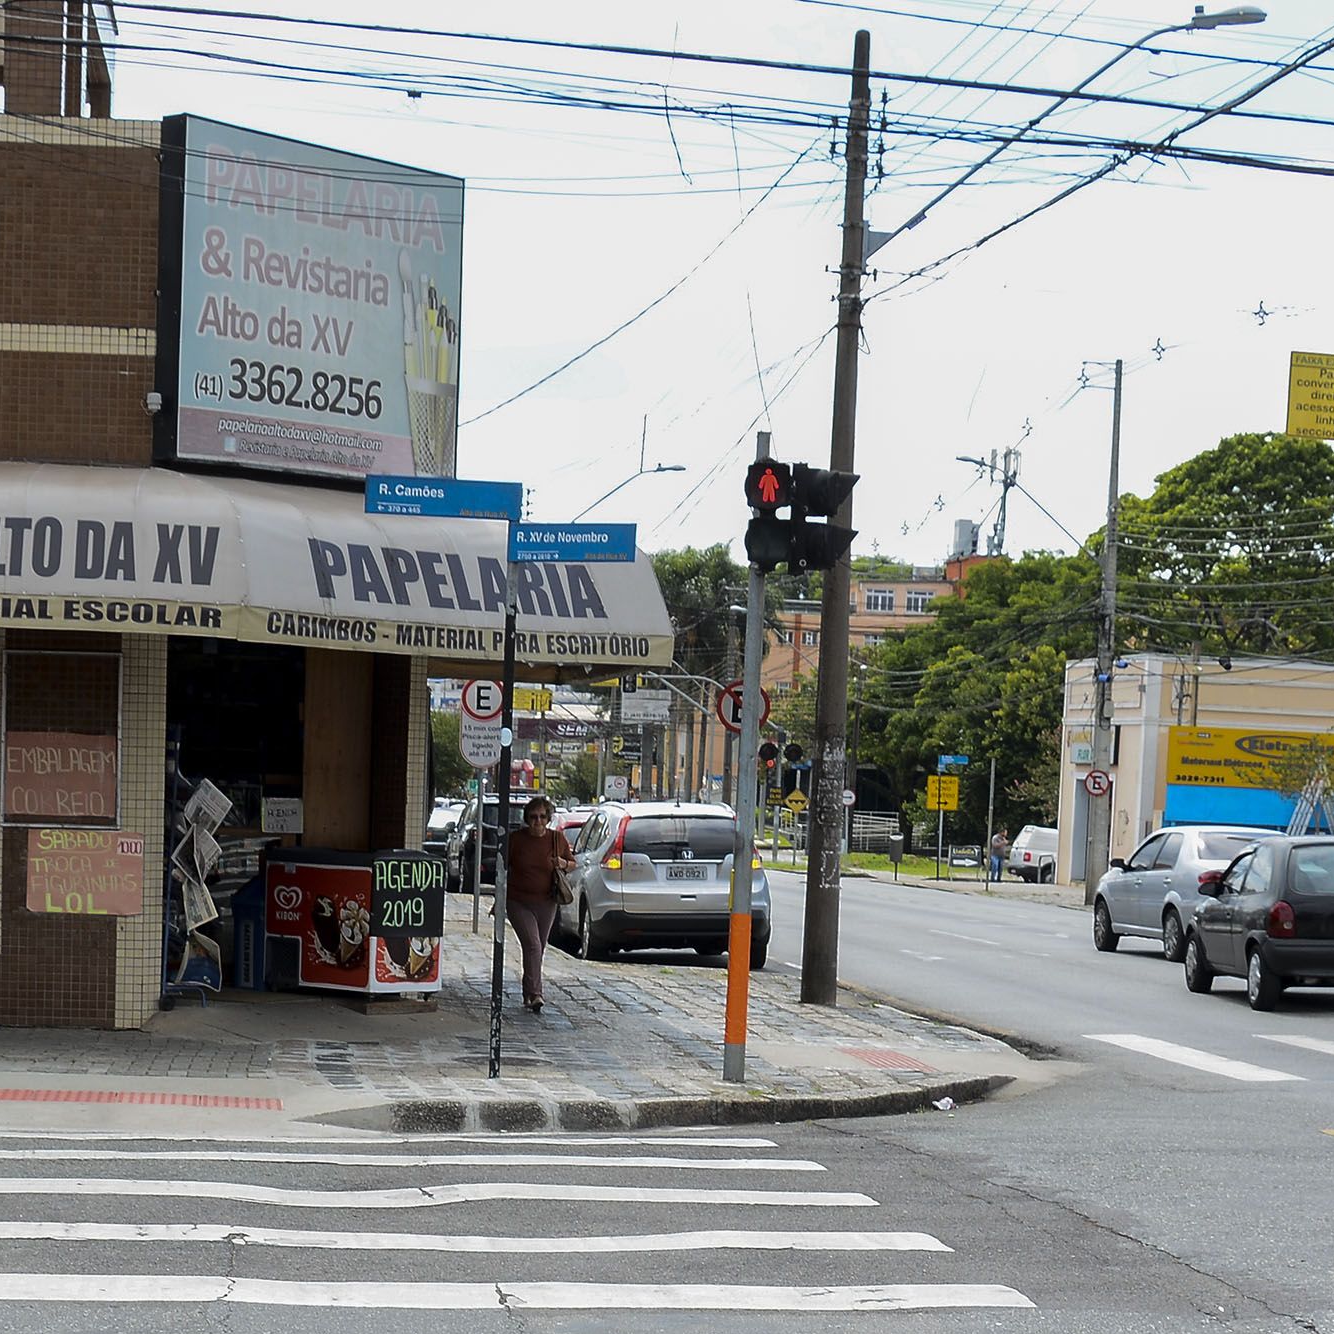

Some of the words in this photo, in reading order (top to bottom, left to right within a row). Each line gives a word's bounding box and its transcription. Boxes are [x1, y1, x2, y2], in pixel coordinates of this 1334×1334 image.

[204, 144, 445, 253] PAPELARIA
[201, 228, 232, 279] &
[242, 237, 389, 306] Revistaria
[197, 296, 259, 342] Alto
[267, 306, 303, 349] da
[311, 312, 355, 356] XV
[1295, 355, 1324, 366] FAIXA
[193, 371, 224, 402] (41)
[228, 358, 383, 420] 3362.8256
[379, 484, 391, 496] R.
[516, 532, 528, 543] R.
[529, 532, 543, 543] XV
[543, 532, 555, 543] de
[558, 532, 609, 543] Novembro
[74, 519, 136, 581] DA
[152, 523, 220, 586] XV
[308, 537, 609, 619] PAPELARIA
[63, 600, 222, 628] ESCOLAR
[267, 611, 377, 643] CARIMBOS
[395, 624, 486, 650] MATERIAL
[493, 631, 541, 654] PRA
[546, 632, 650, 657] ESCRITÓRIO
[476, 685, 492, 711] E
[7, 747, 116, 775] EMBALAGEM
[30, 856, 92, 873] TROCA
[374, 860, 444, 892] AGENDA
[31, 874, 137, 894] FIGURINHAS
[45, 892, 108, 915] LOL
[275, 911, 300, 921] KIBON
[382, 897, 425, 927] 2019
